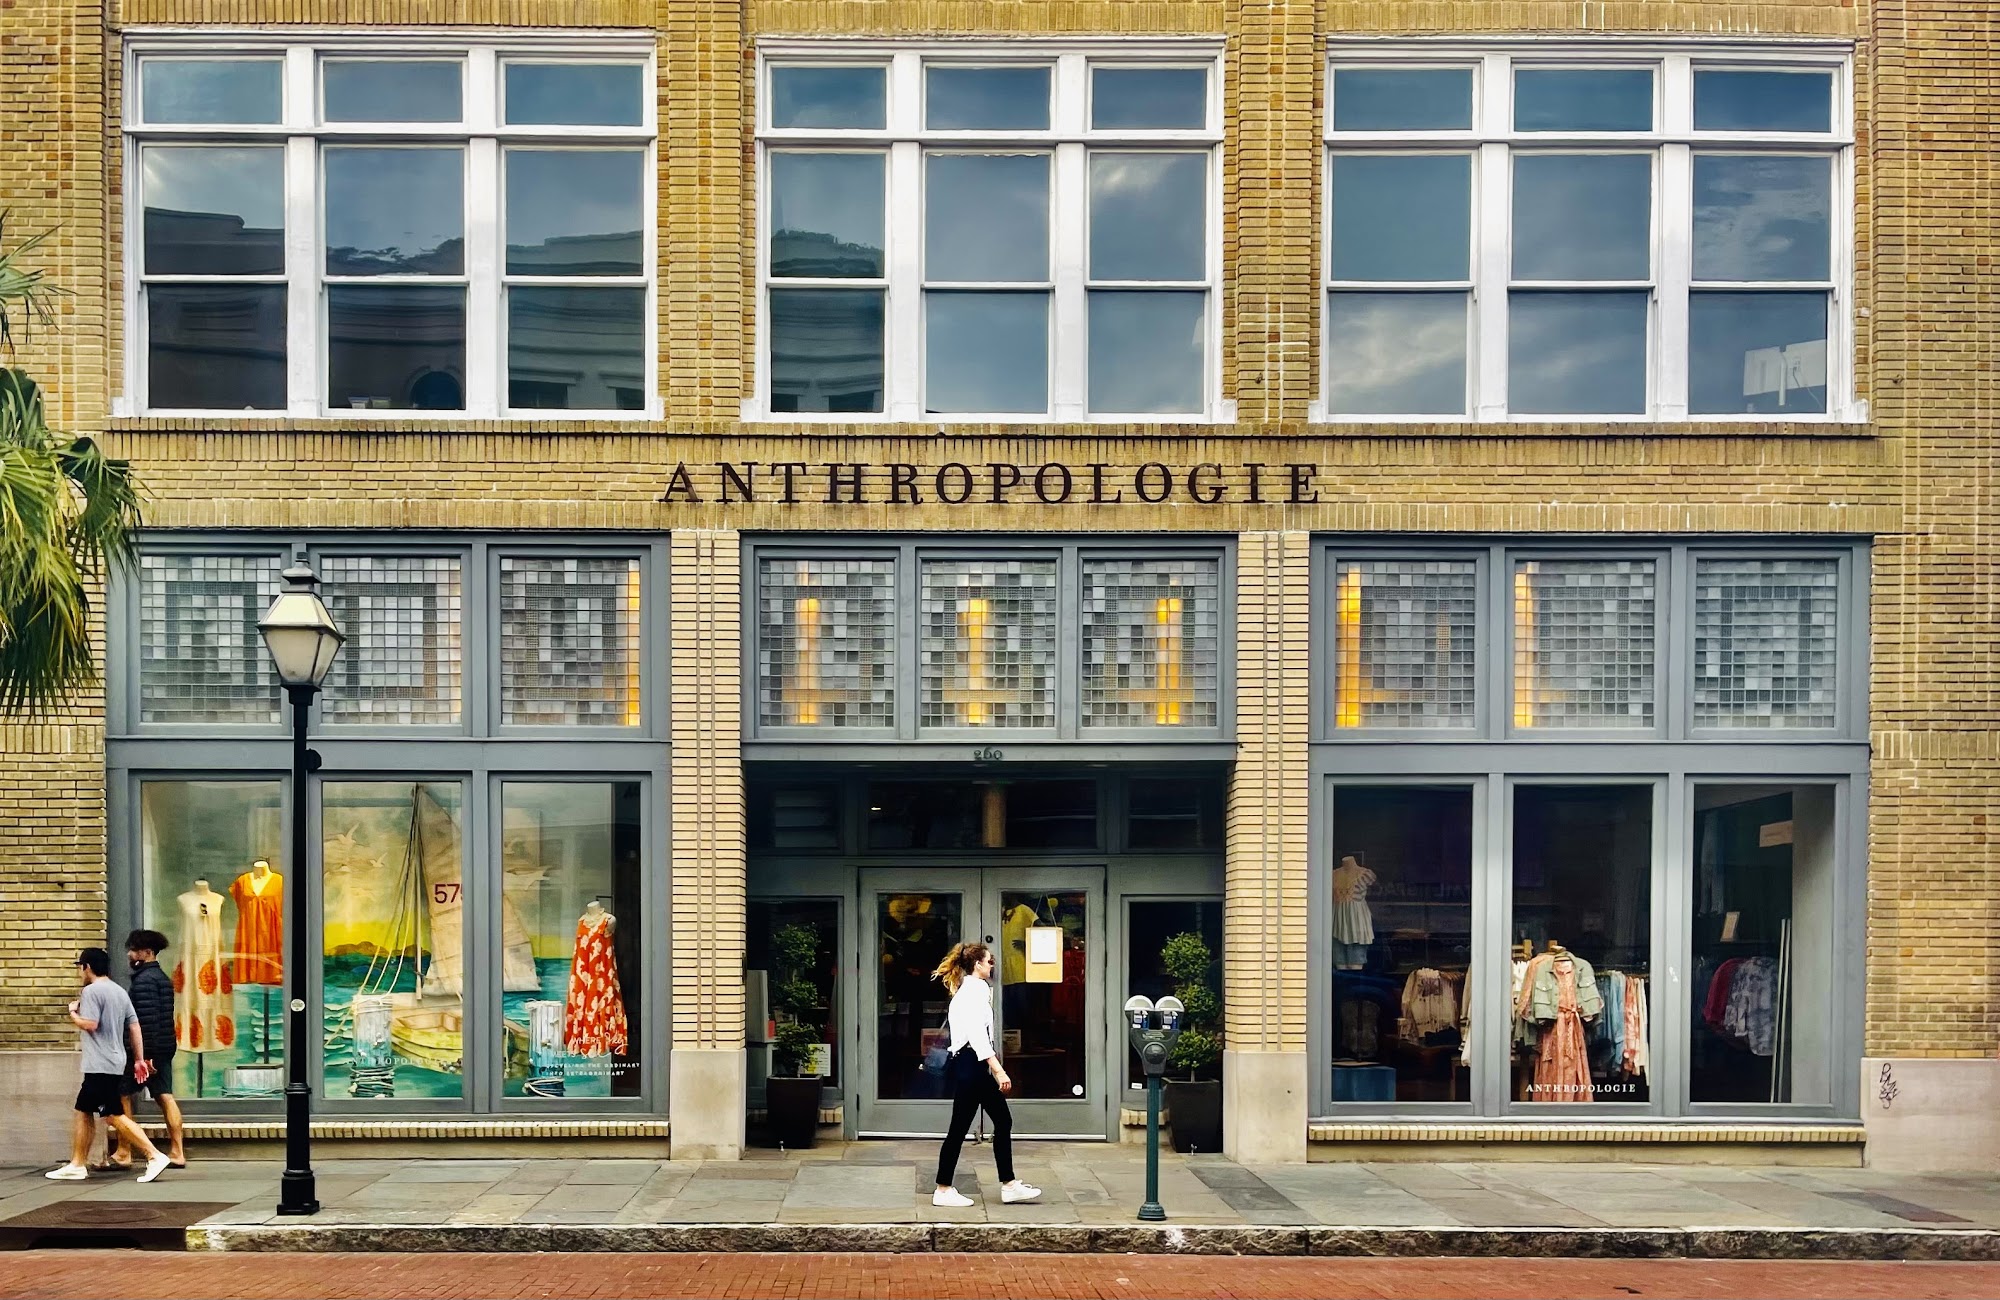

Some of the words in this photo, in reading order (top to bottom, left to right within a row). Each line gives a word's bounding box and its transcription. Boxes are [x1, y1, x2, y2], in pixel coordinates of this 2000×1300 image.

[662, 460, 1320, 504] ANTHROPOLOGIE
[974, 746, 1002, 760] 260
[573, 1037, 601, 1045] WHERE
[1525, 1084, 1636, 1093] ANTHROPOLOGIE
